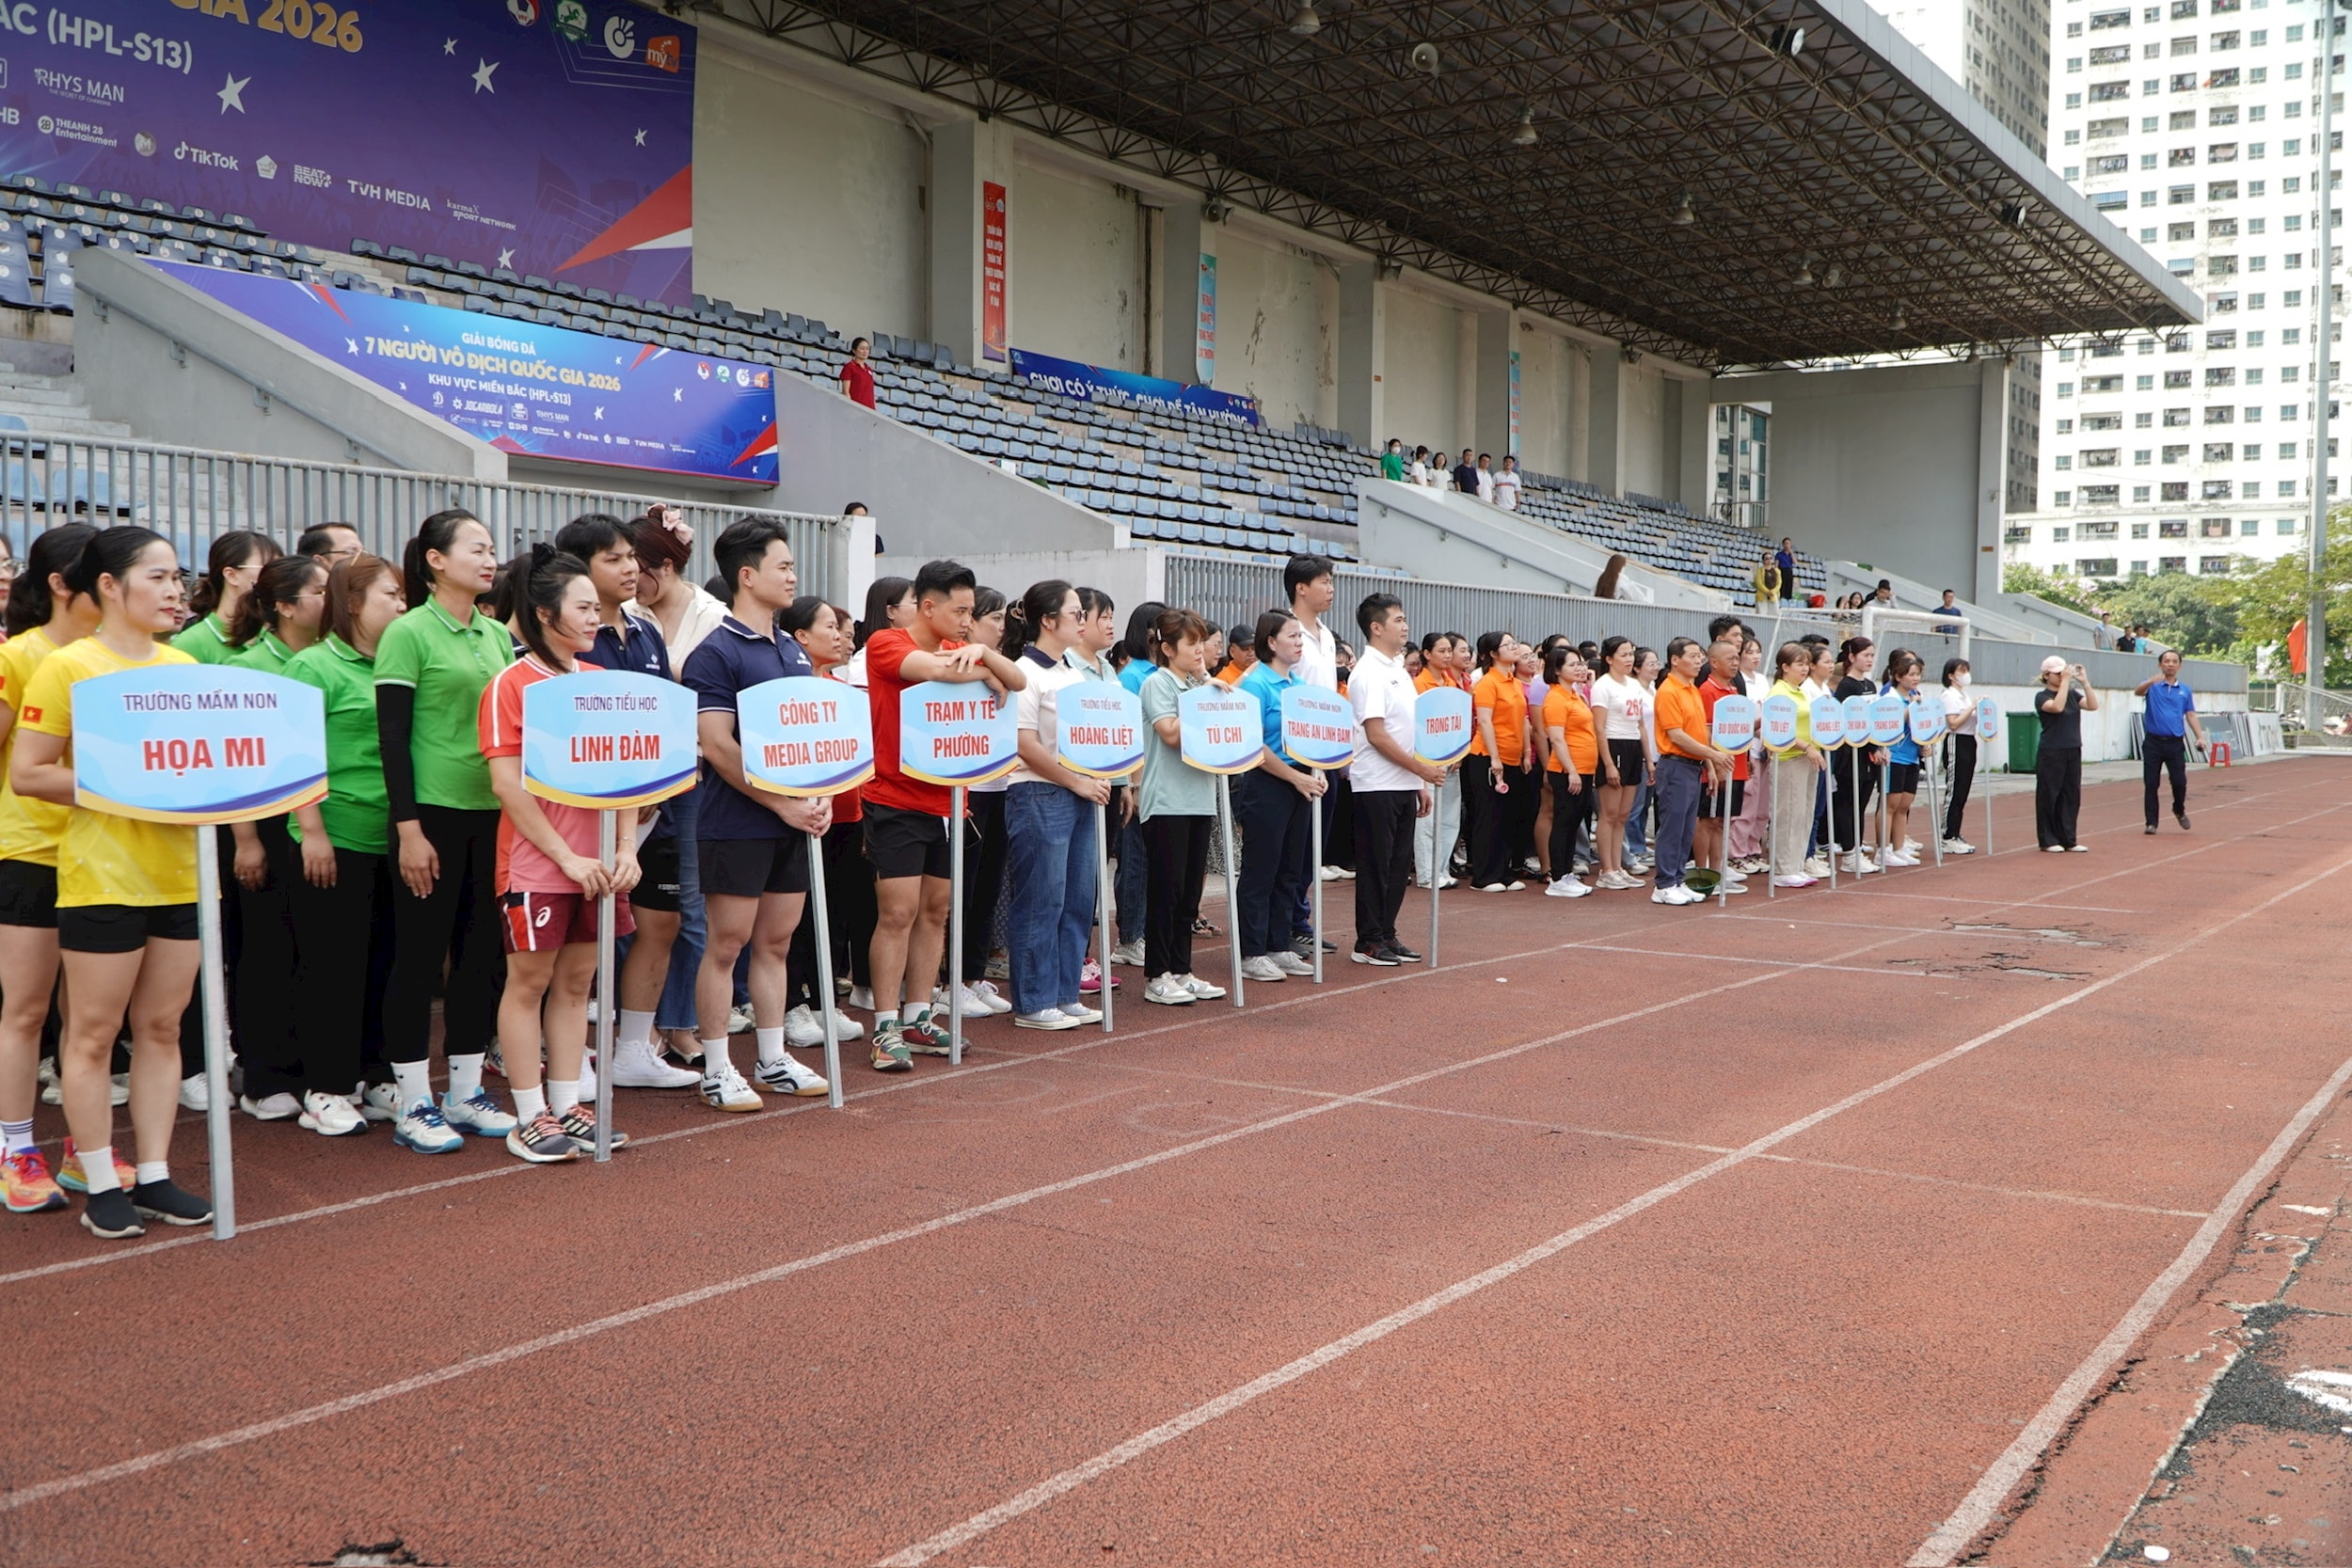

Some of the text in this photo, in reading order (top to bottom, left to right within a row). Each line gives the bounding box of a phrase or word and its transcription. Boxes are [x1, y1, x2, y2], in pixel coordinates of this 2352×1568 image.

[258, 0, 363, 54] 2026
[48, 8, 192, 75] (HPL-S13)
[34, 68, 82, 92] RHYS
[87, 79, 124, 103] MAN
[56, 118, 103, 135] THEANH 28
[56, 128, 117, 148] Entertainment
[191, 148, 239, 171] TikTok
[385, 188, 431, 211] MEDIA
[453, 210, 516, 230] SPORT NETWORK
[486, 335, 518, 352] BÓNG
[520, 341, 536, 356] ĐÁ
[364, 336, 621, 391] 7 NGƯỜI VÔ ĐỊCH QUỐC GIA 2026
[428, 373, 452, 387] KHU
[453, 376, 476, 391] VỰC
[529, 388, 571, 406] (HPL-S13)
[1065, 377, 1086, 397] CÓ
[123, 689, 278, 711] TRƯỜNG MẦM NON
[574, 691, 658, 713] TRƯỜNG TIỂU HỌC
[779, 698, 836, 726] CÔNG TY
[925, 692, 995, 726] TRẠM Y TẾ
[1070, 722, 1134, 751] HOÀNG LIỆT
[1206, 724, 1243, 744] TÚ CHI
[1311, 723, 1321, 739] AN
[1322, 725, 1336, 741] LINH
[1426, 716, 1449, 737] TRỌNG
[144, 737, 266, 776] HỌA MI
[571, 730, 660, 763] LINH ĐÀM
[764, 738, 858, 768] MEDIA GROUP
[933, 731, 989, 758] PHƯỜNG
